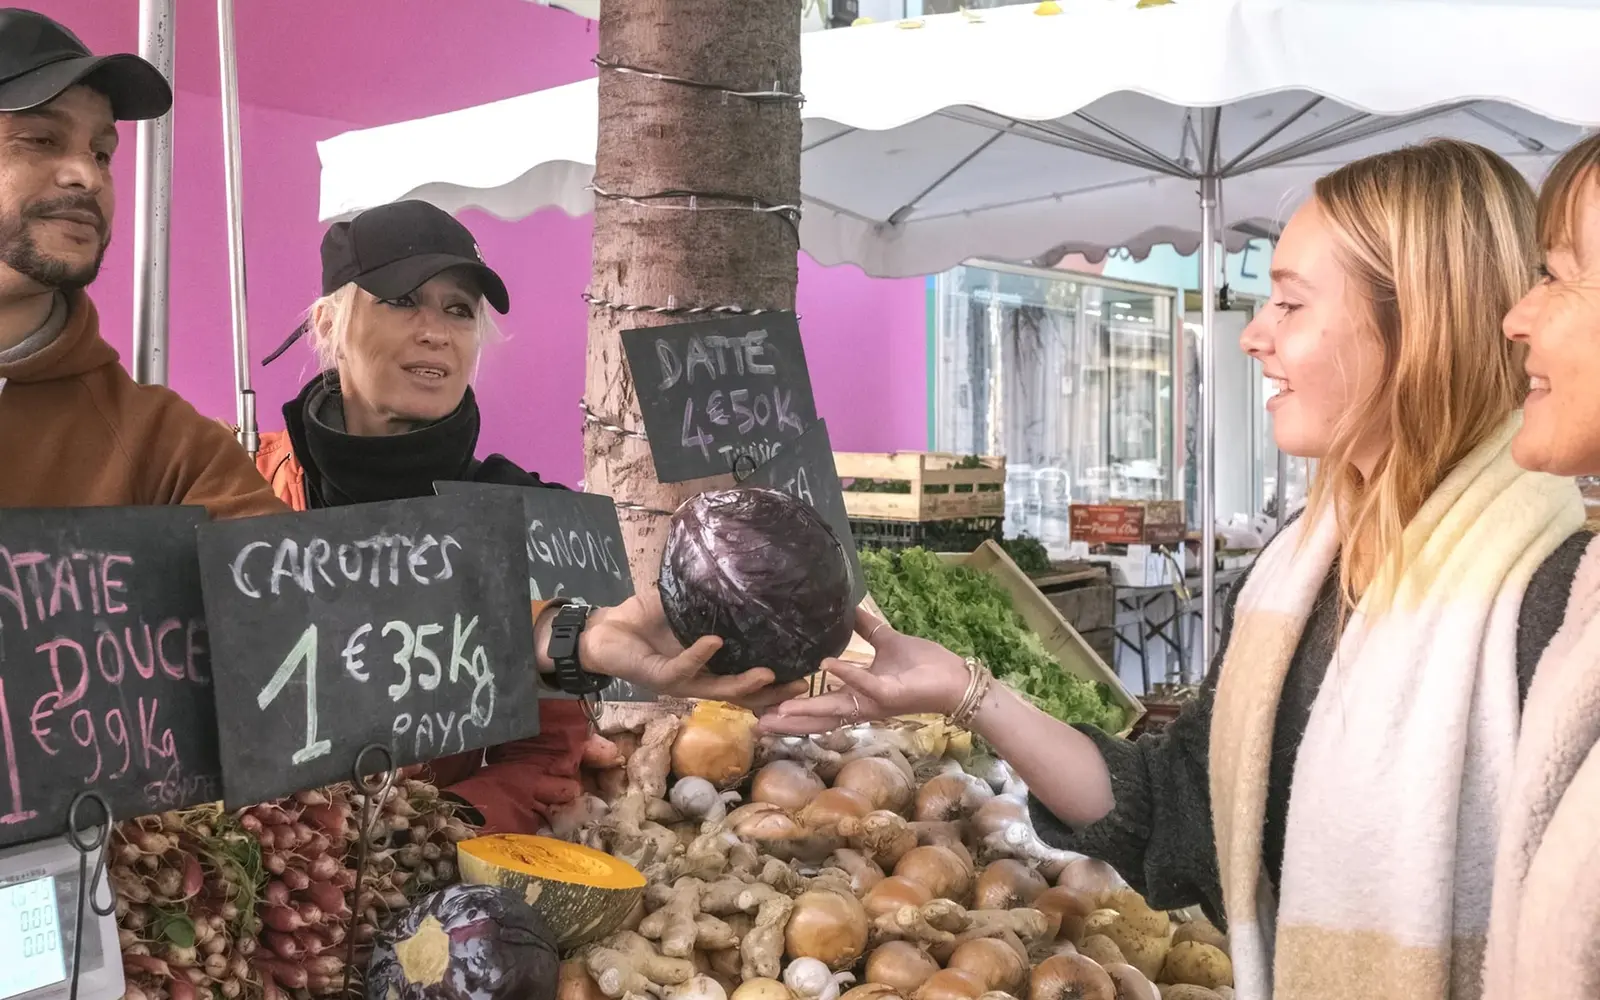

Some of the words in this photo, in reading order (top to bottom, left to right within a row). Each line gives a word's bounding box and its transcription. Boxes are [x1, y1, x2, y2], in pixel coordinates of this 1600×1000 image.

[655, 329, 777, 391] DATTE
[0, 543, 134, 630] ATATE
[230, 534, 462, 599] CAROTTES
[35, 616, 210, 709] DOUCE
